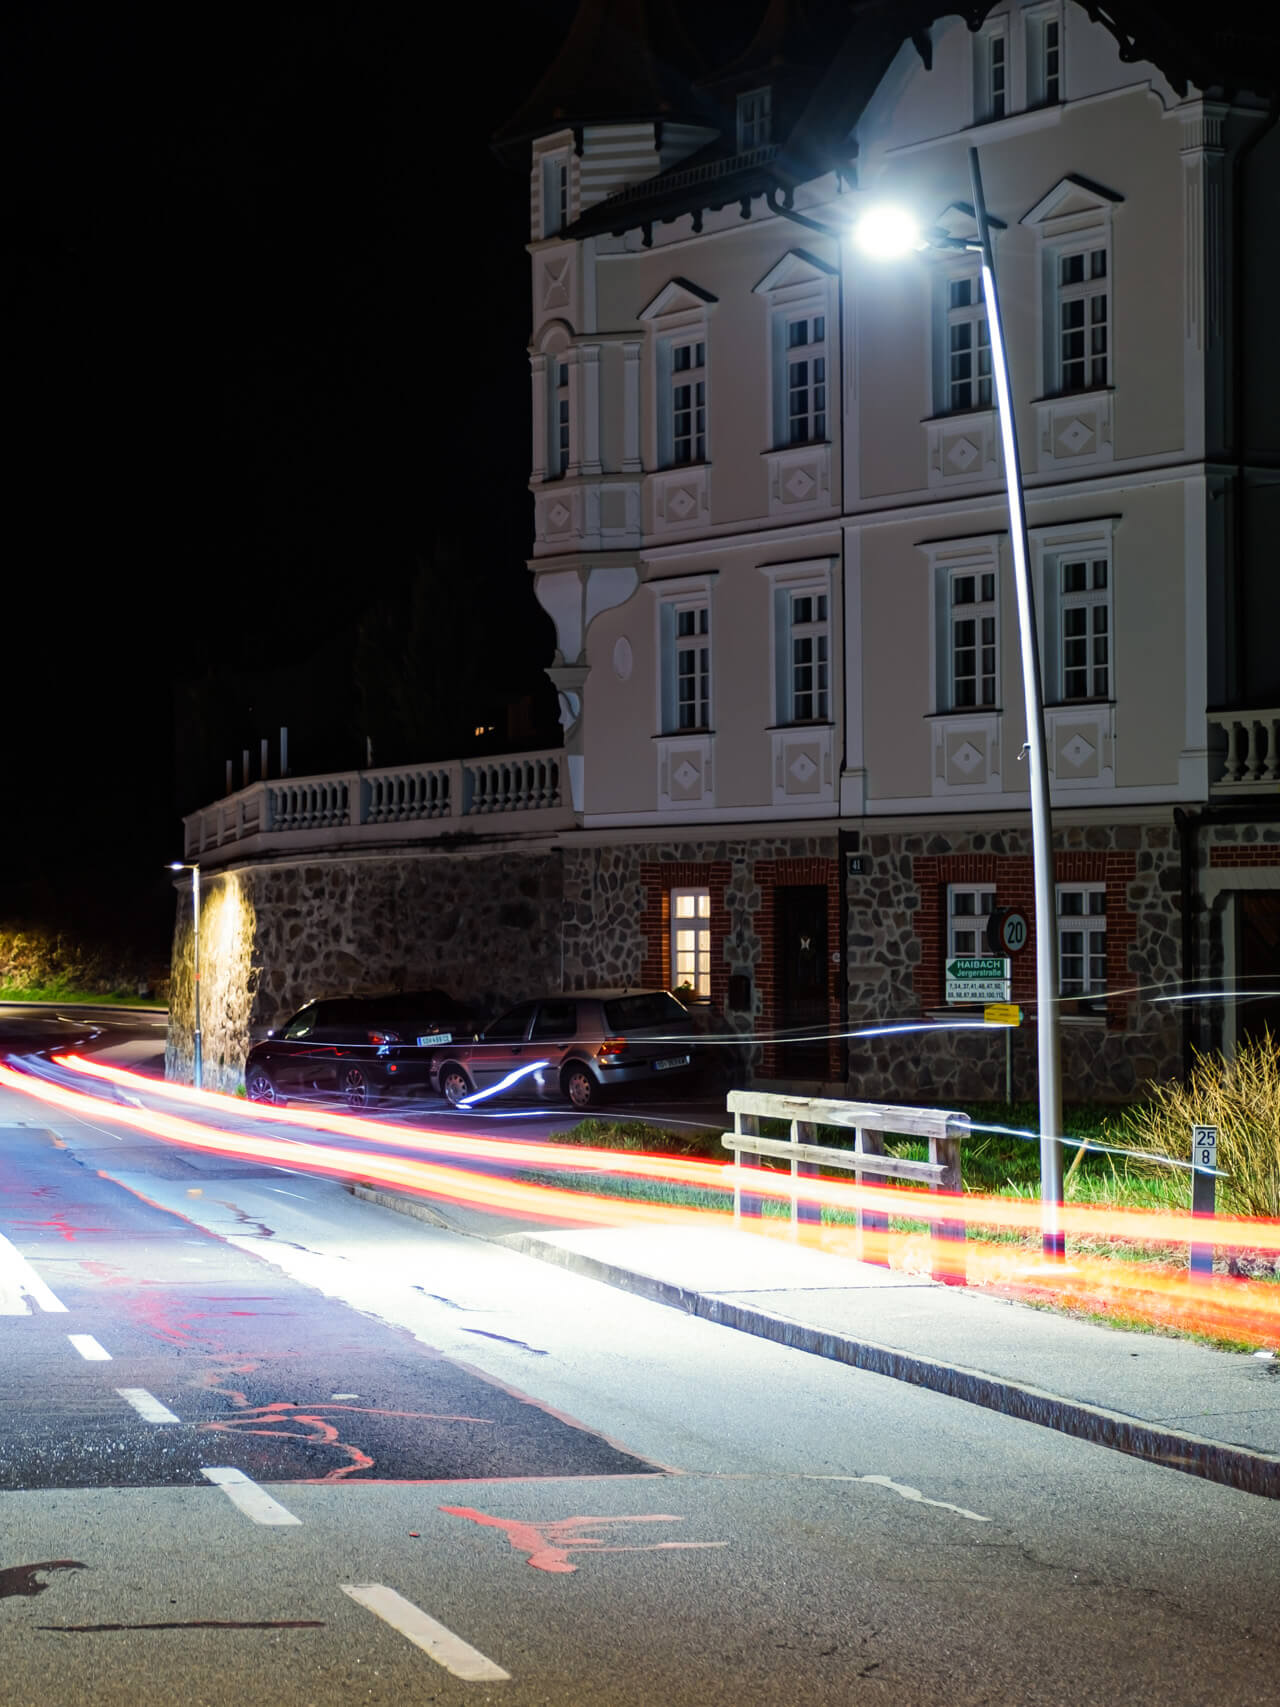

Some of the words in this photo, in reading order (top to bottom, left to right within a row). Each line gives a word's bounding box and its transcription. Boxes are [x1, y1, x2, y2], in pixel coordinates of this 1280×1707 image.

[1007, 921, 1023, 944] 20
[957, 960, 1001, 969] HAIBACH
[1197, 1131, 1216, 1146] 25
[1202, 1149, 1210, 1164] 8
